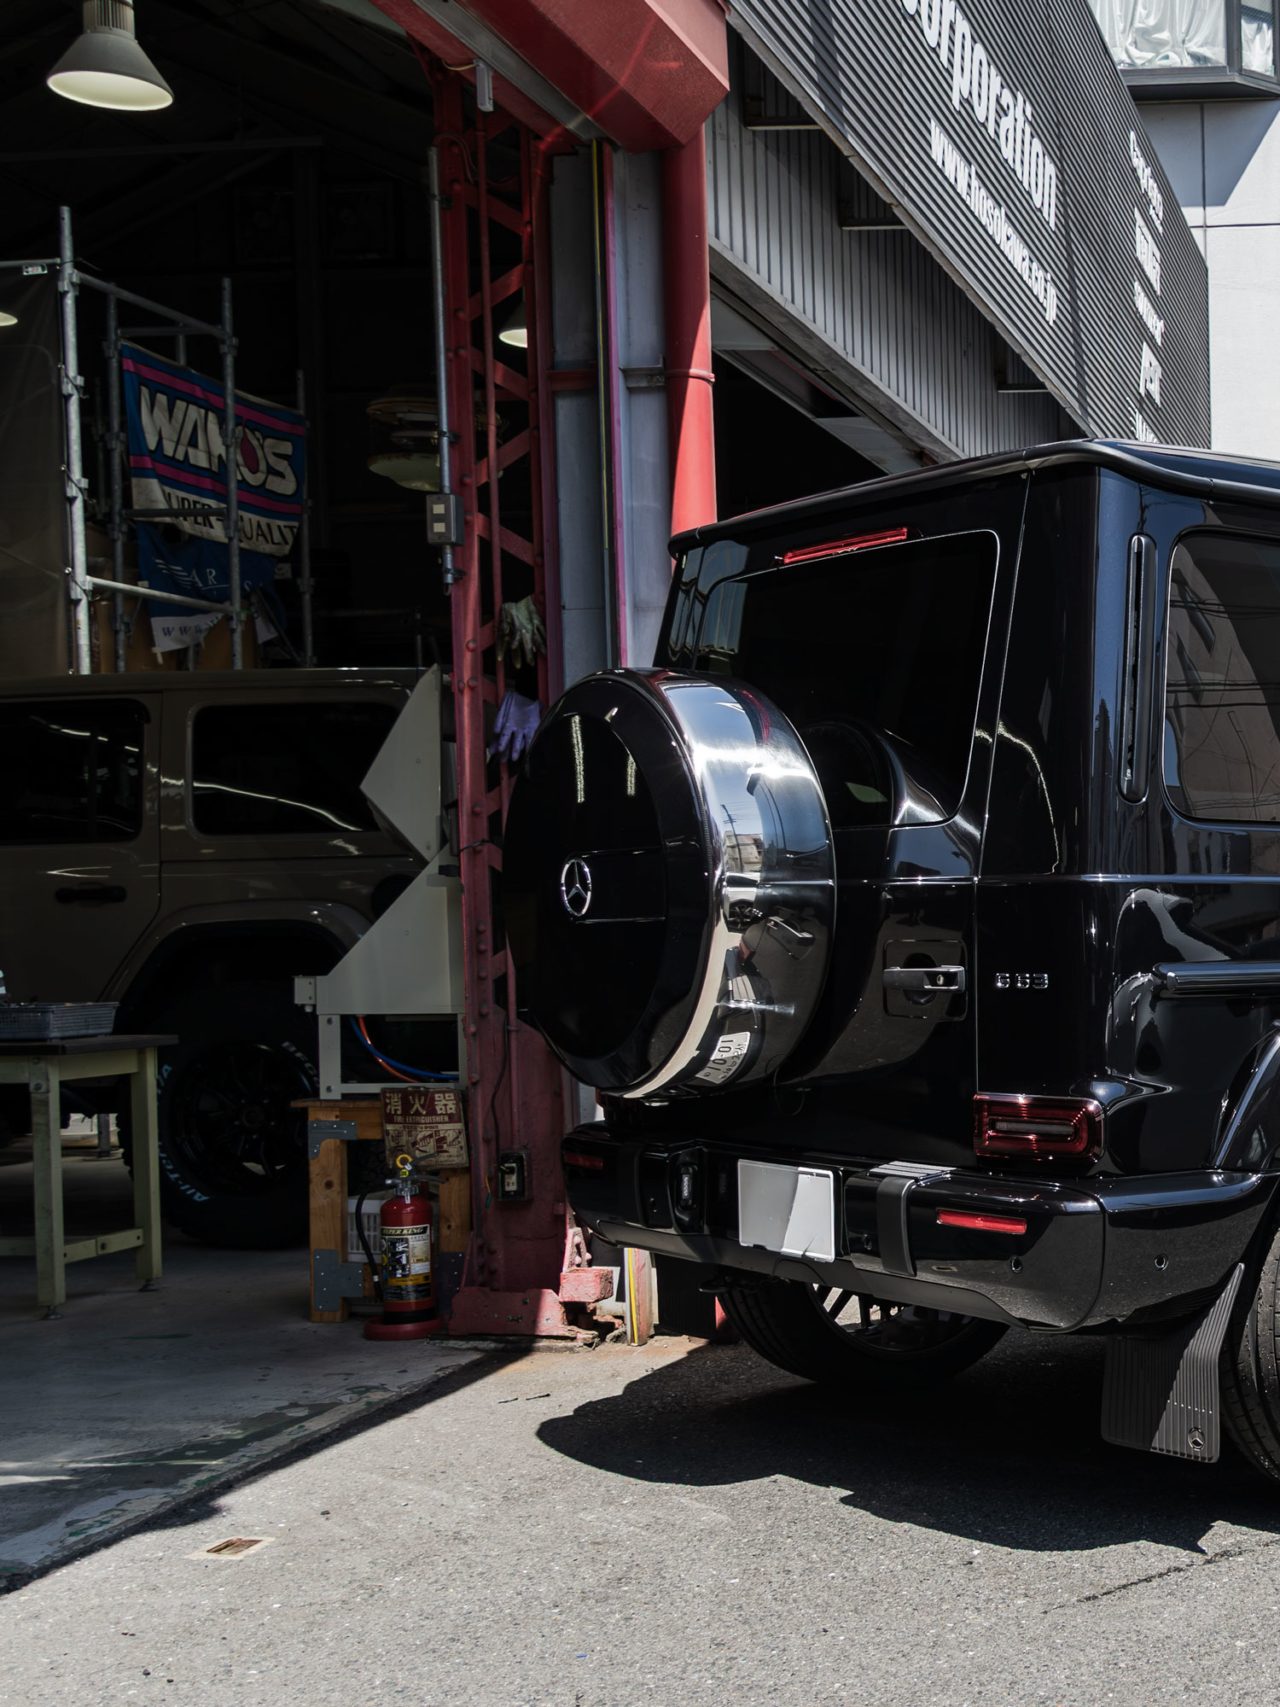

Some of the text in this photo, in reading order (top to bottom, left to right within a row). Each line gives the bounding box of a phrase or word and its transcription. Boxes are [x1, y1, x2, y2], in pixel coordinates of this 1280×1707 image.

[902, 0, 1057, 231] orporation
[930, 118, 1057, 325] www.hosokawa.co.jp
[385, 1092, 457, 1115] 消火器
